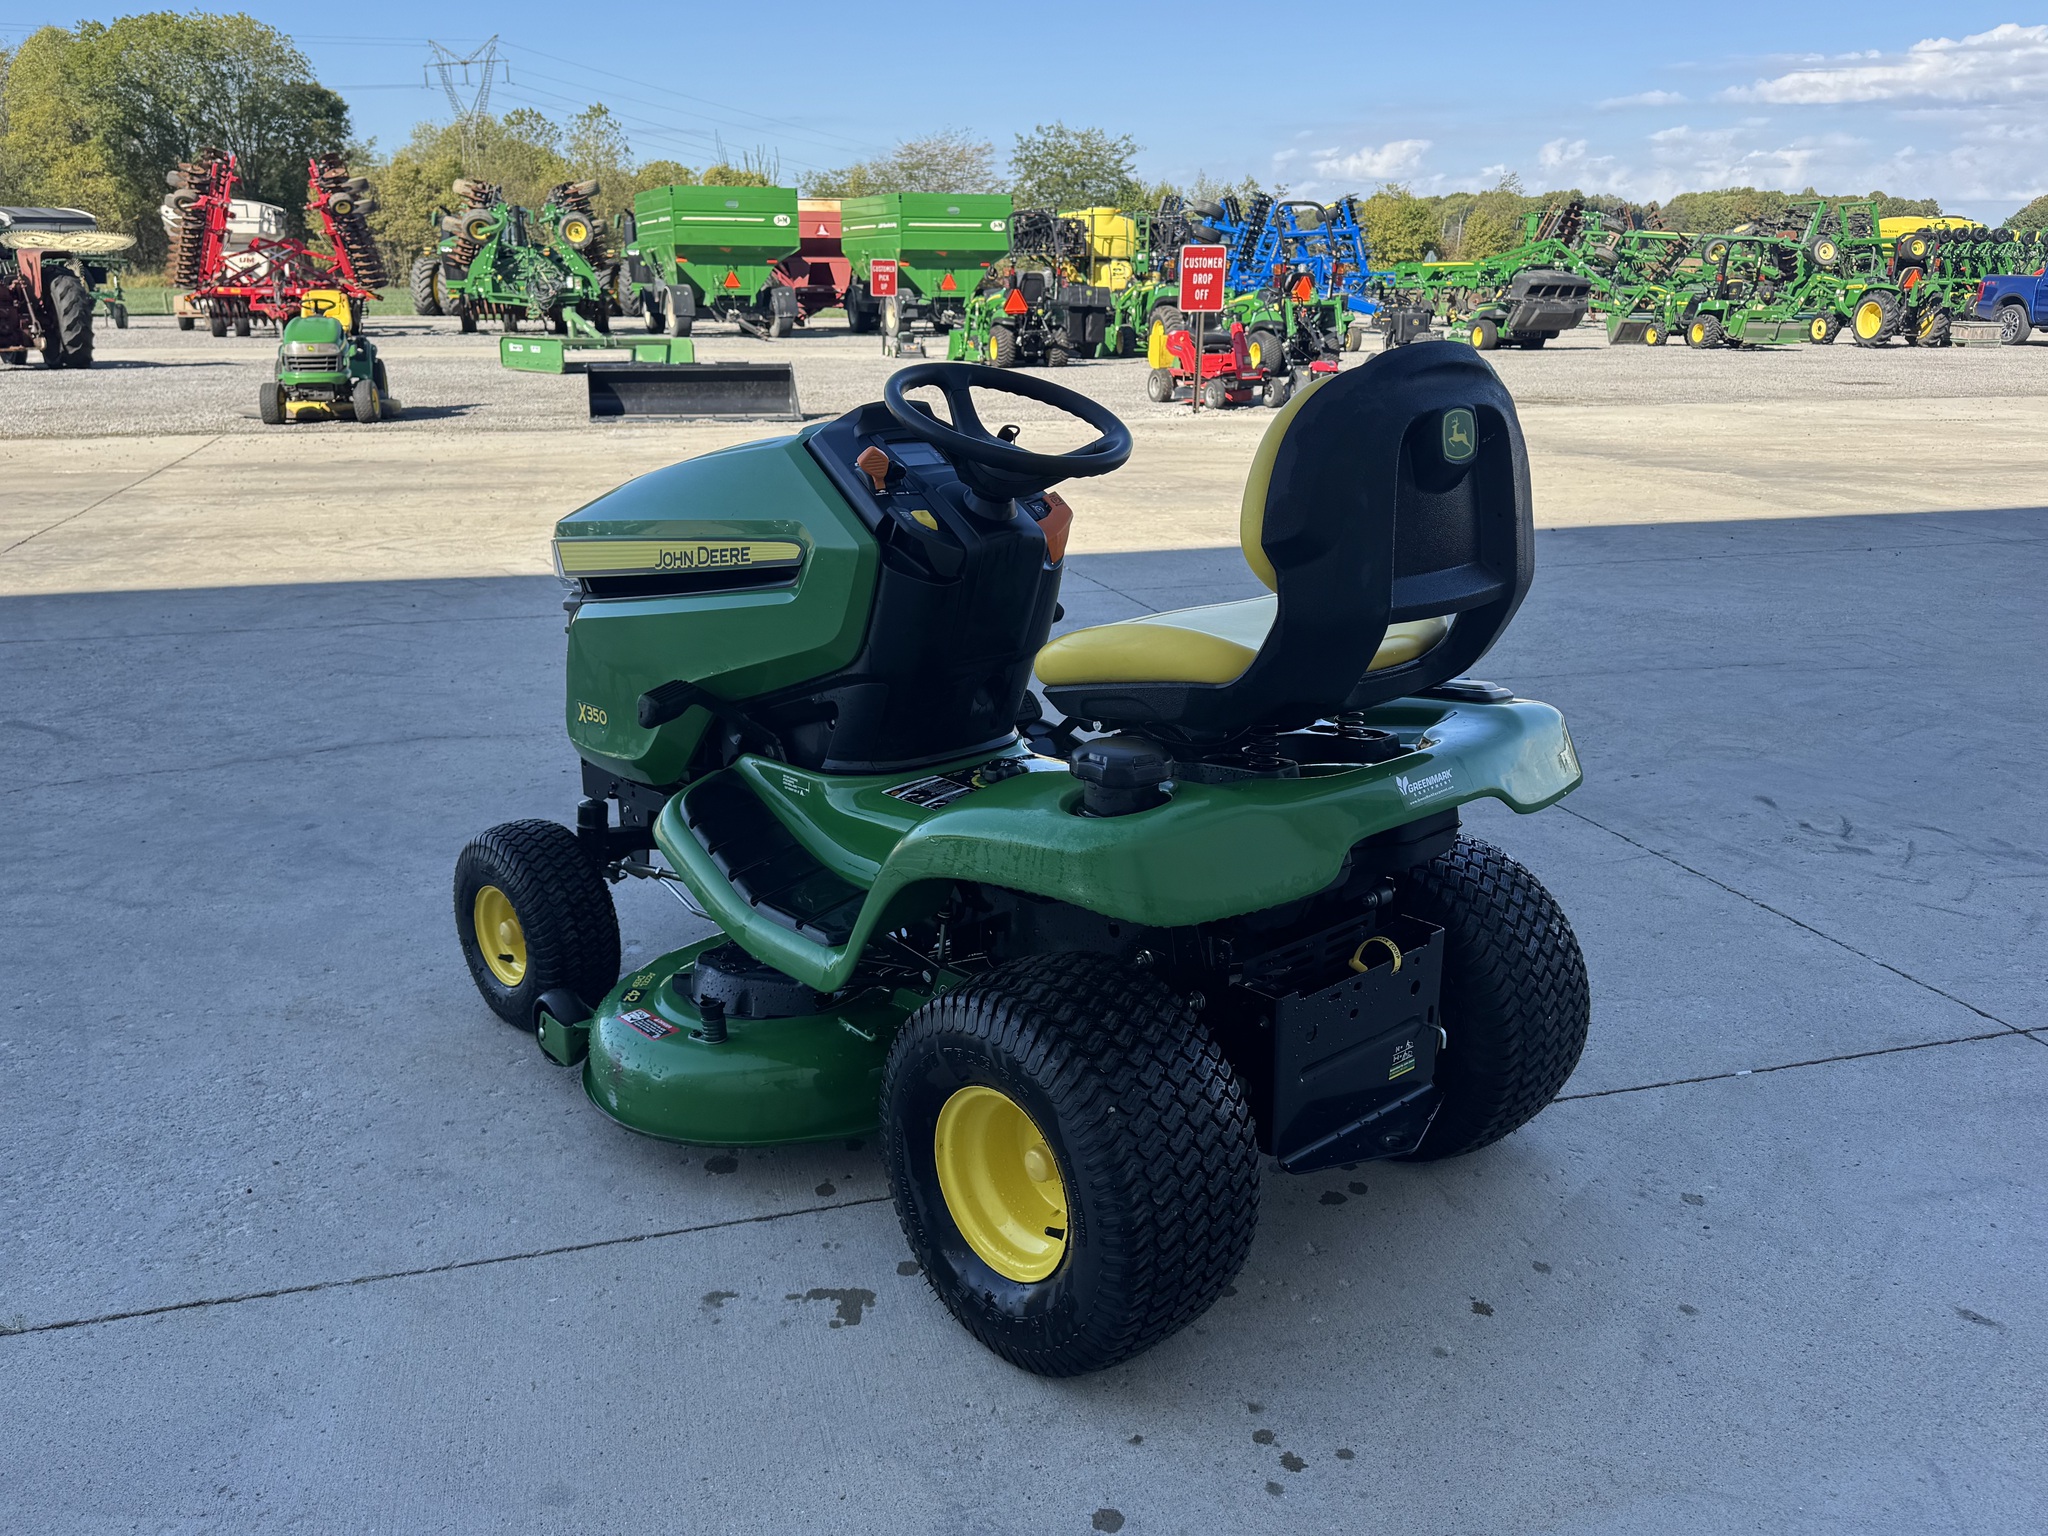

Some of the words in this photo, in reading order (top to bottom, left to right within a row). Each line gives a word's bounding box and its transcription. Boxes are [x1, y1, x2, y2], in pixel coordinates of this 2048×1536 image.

[1184, 257, 1223, 268] CUSTOMER
[872, 265, 895, 273] CUSTOMER
[878, 274, 890, 282] PICK
[1193, 273, 1213, 285] DROP
[880, 283, 888, 291] UP
[1194, 289, 1209, 300] OFF
[655, 548, 694, 569] JOHN
[697, 546, 751, 566] DEERE
[577, 702, 607, 725] X350
[1407, 769, 1453, 793] GREENMARK
[1413, 779, 1452, 797] EQUIPMENT
[623, 990, 641, 1002] 42
